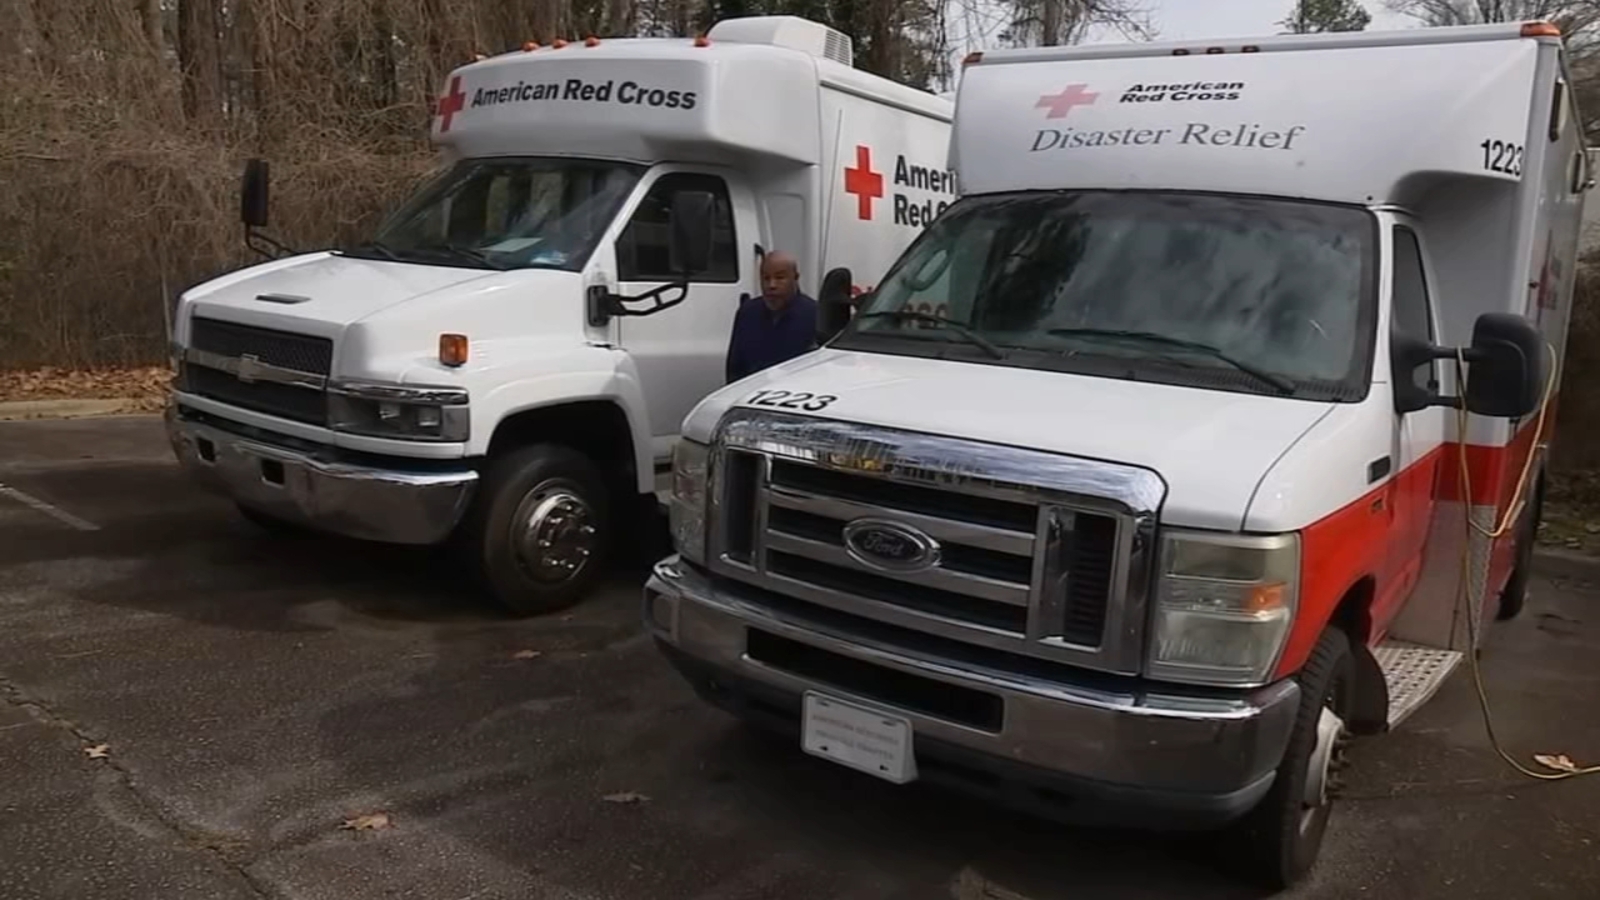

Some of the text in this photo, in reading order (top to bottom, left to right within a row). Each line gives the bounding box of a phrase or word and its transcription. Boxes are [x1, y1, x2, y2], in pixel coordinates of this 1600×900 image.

[471, 79, 697, 110] American Red Cross
[1119, 90, 1240, 103] Red Cross
[1127, 81, 1245, 93] American
[1029, 122, 1306, 152] Disaster Relief
[1480, 138, 1524, 177] 1223
[894, 193, 932, 228] Red
[747, 390, 838, 411] 1223
[863, 531, 905, 556] Ford
